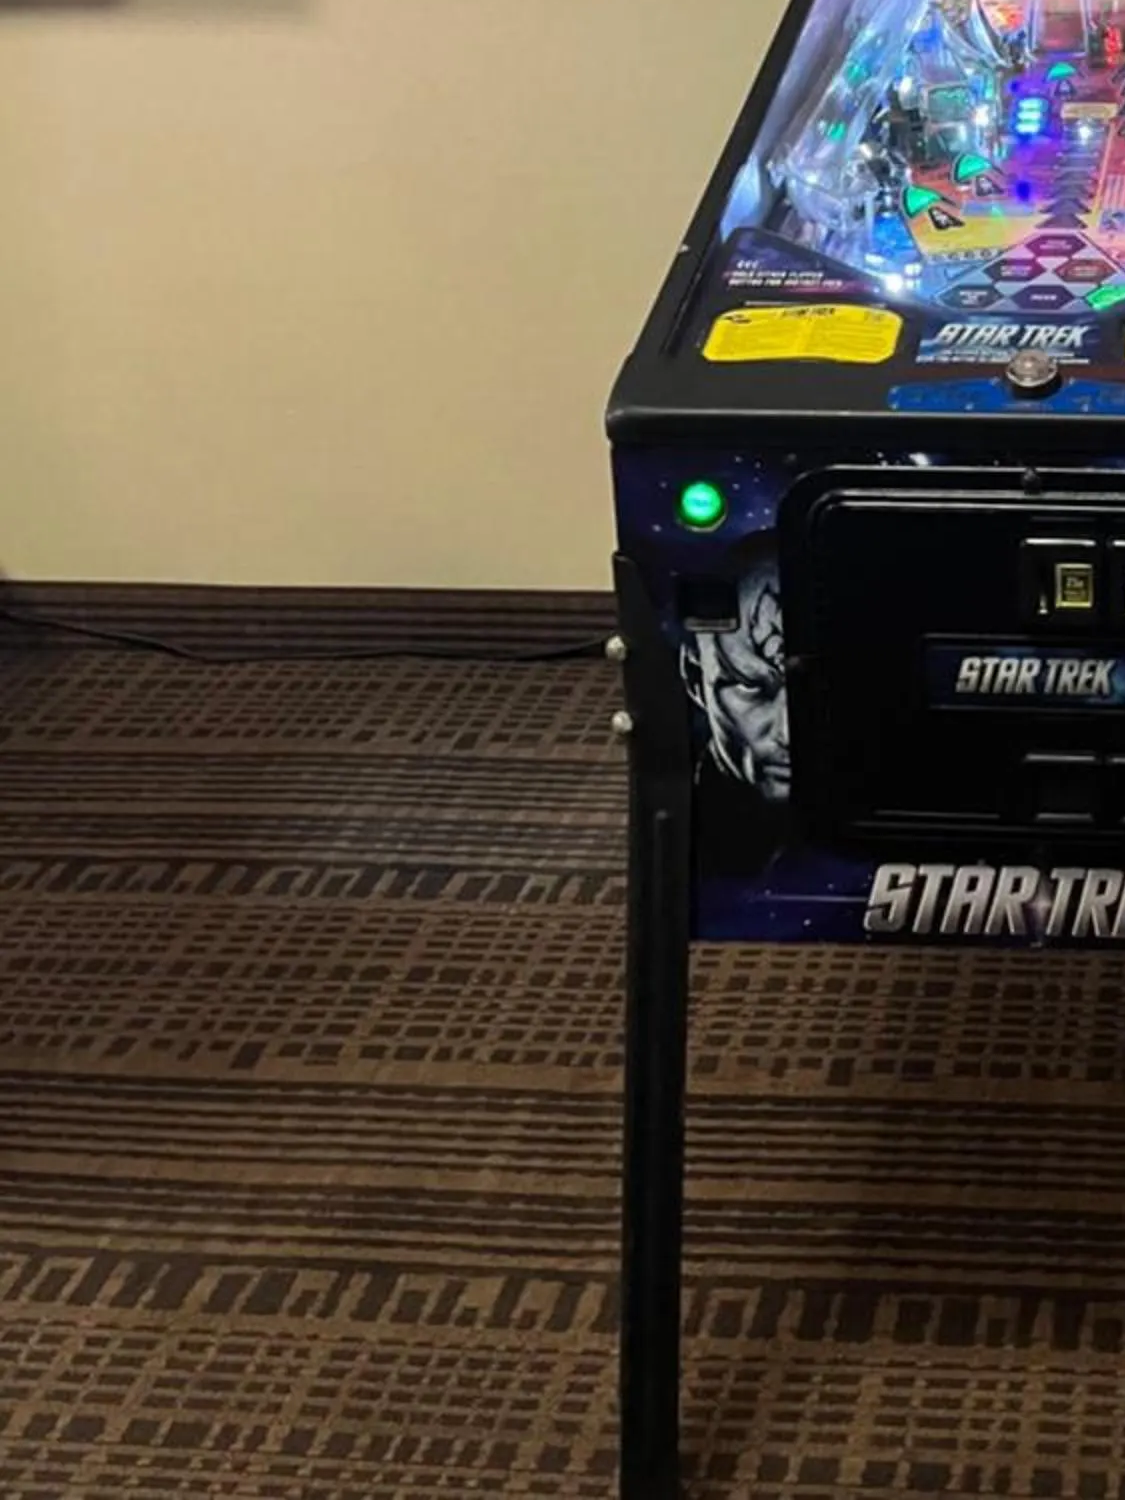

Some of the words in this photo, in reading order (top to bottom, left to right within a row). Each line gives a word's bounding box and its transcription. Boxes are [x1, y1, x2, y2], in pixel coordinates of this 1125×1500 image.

[1017, 323, 1091, 349] TREK
[954, 656, 1041, 694] STAR
[1043, 658, 1116, 695] TREK
[863, 863, 1041, 936] STAR
